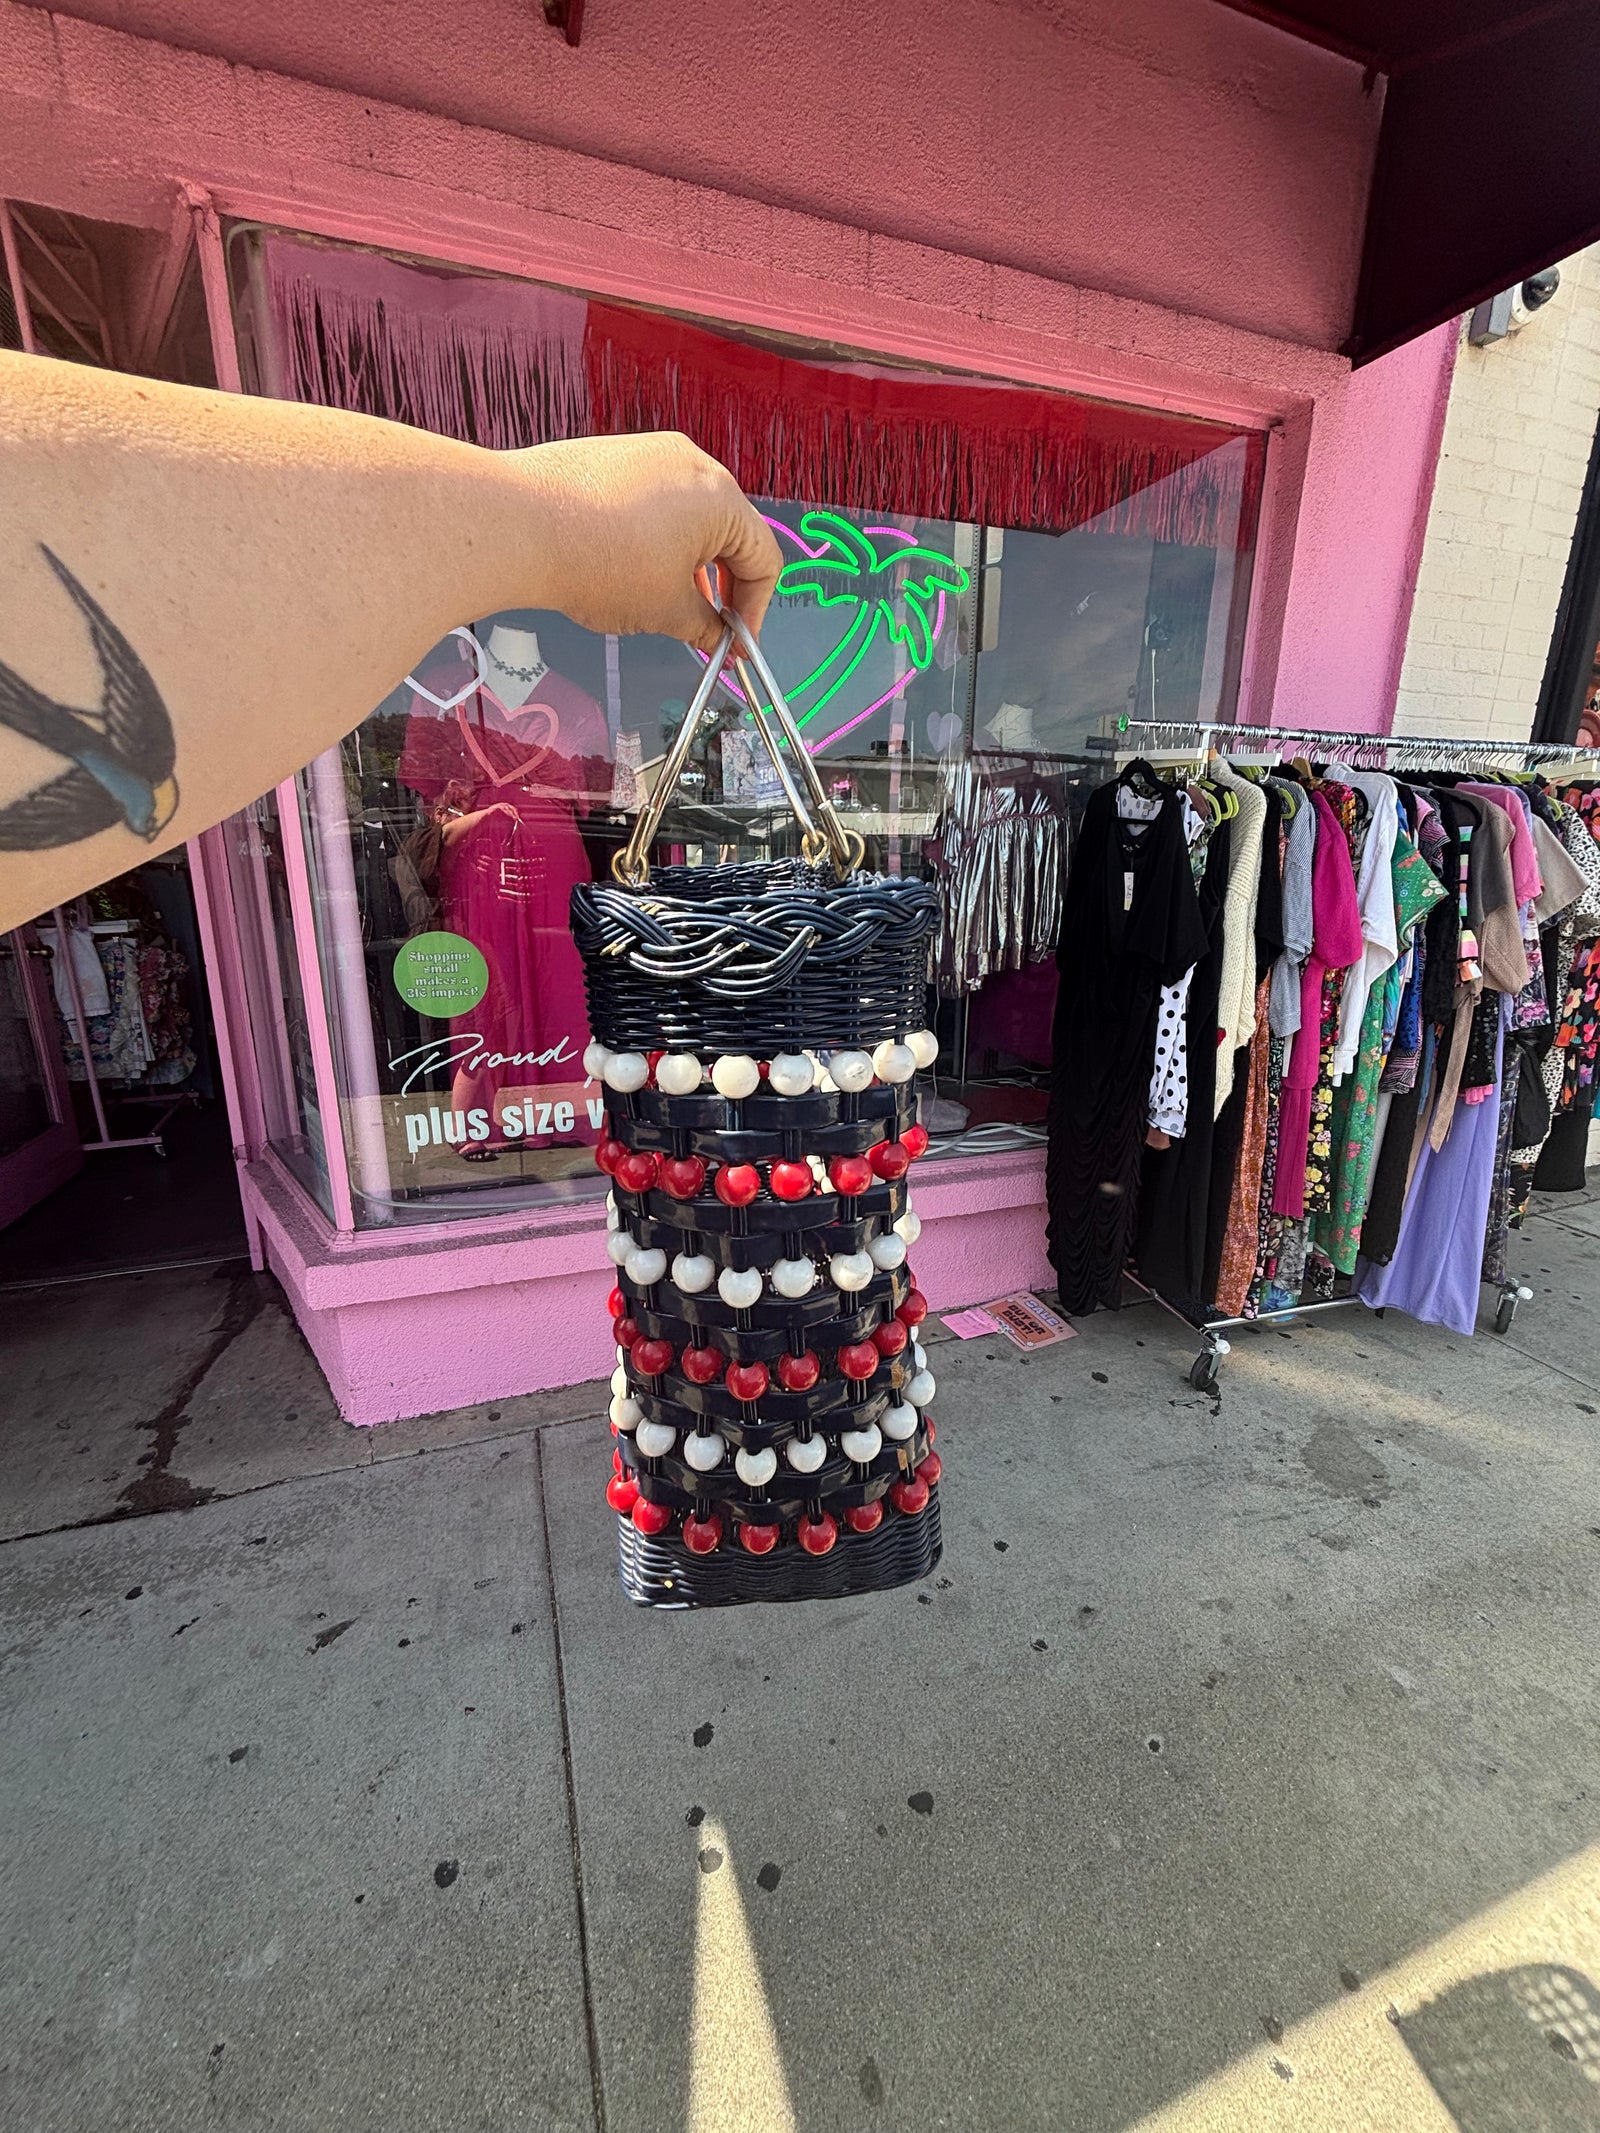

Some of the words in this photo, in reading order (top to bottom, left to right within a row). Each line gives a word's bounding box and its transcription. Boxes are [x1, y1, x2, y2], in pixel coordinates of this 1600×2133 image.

[409, 951, 470, 963] Shopping
[424, 963, 459, 974] small
[415, 976, 457, 986] makes
[461, 977, 469, 985] a
[407, 988, 427, 998] BIG
[431, 986, 479, 999] impact!
[405, 1106, 490, 1153] plus
[501, 1097, 574, 1136] size
[1001, 1310, 1034, 1334] BUST!
[1008, 1304, 1031, 1320] BUY
[1028, 1321, 1046, 1335] OR
[1024, 1300, 1060, 1326] SALE
